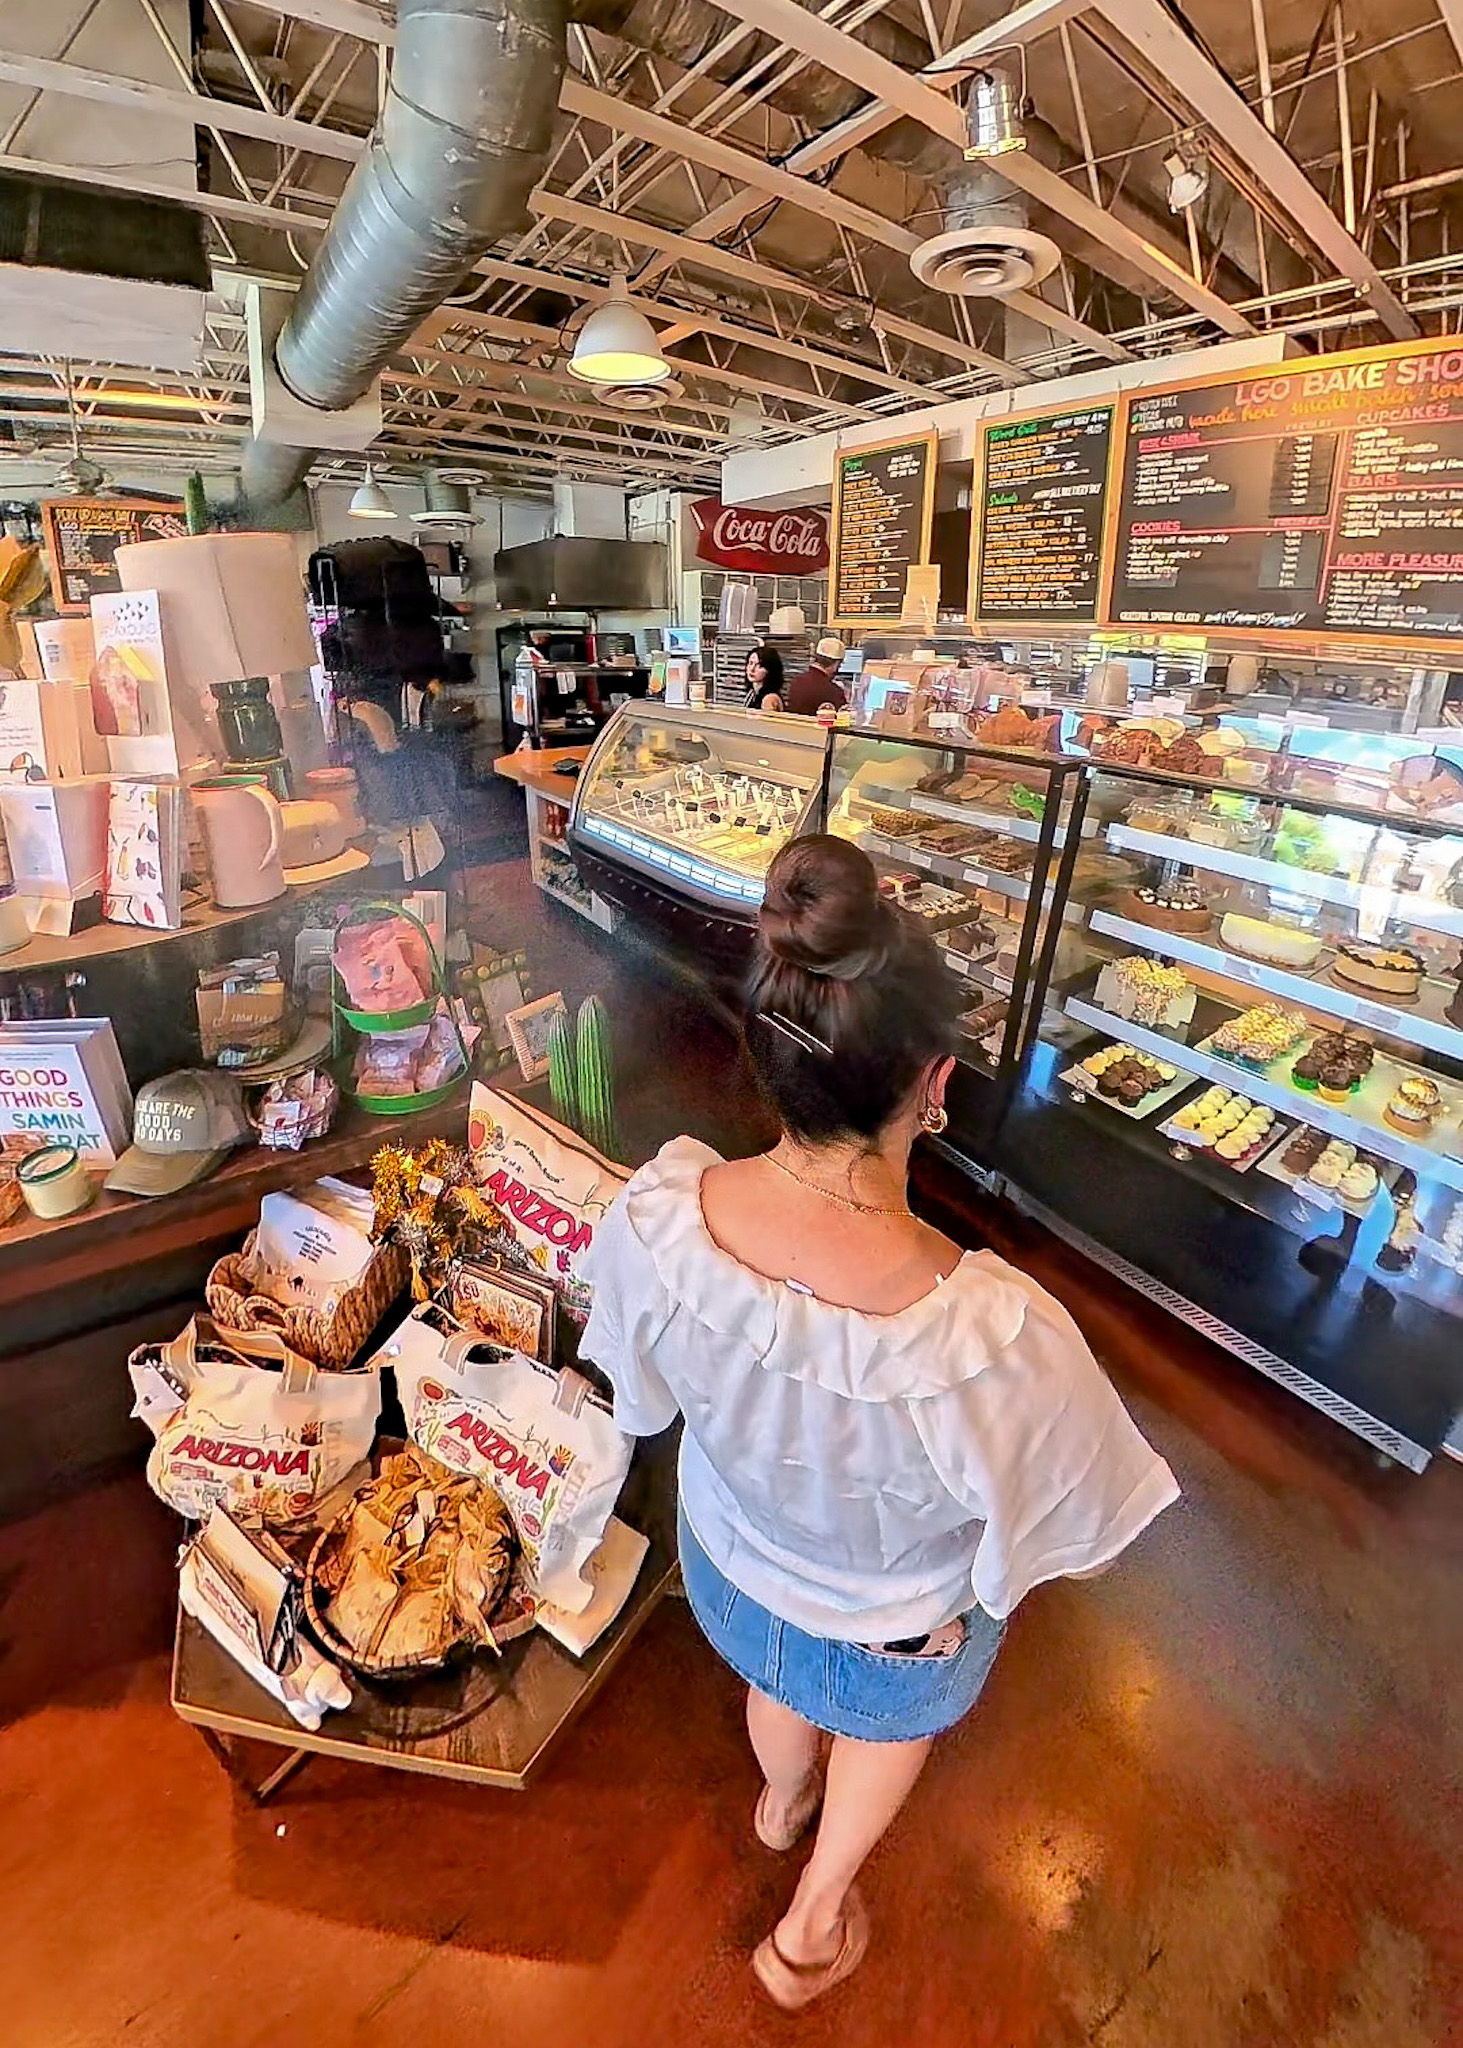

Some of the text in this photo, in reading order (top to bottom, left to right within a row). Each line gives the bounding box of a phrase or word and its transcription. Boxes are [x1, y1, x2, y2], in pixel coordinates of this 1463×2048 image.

[1235, 379, 1291, 406] LGO
[1302, 362, 1389, 397] BAKE
[1356, 403, 1450, 425] CUPCAKES
[1348, 474, 1398, 487] BARS
[713, 508, 821, 556] Coca-Cola
[1131, 520, 1181, 533] COOKIES
[1337, 552, 1385, 566] MORE
[0, 1069, 67, 1086] GOOD
[0, 1091, 83, 1108] THINGS
[149, 1101, 170, 1115] ARE
[172, 1103, 196, 1120] THE
[12, 1113, 86, 1129] SAMIN
[139, 1111, 170, 1129] GOOD
[149, 1128, 181, 1142] DAYS
[483, 1167, 593, 1253] ARIZON
[169, 1434, 310, 1476] ARIZONA
[444, 1411, 552, 1501] ARIZONA
